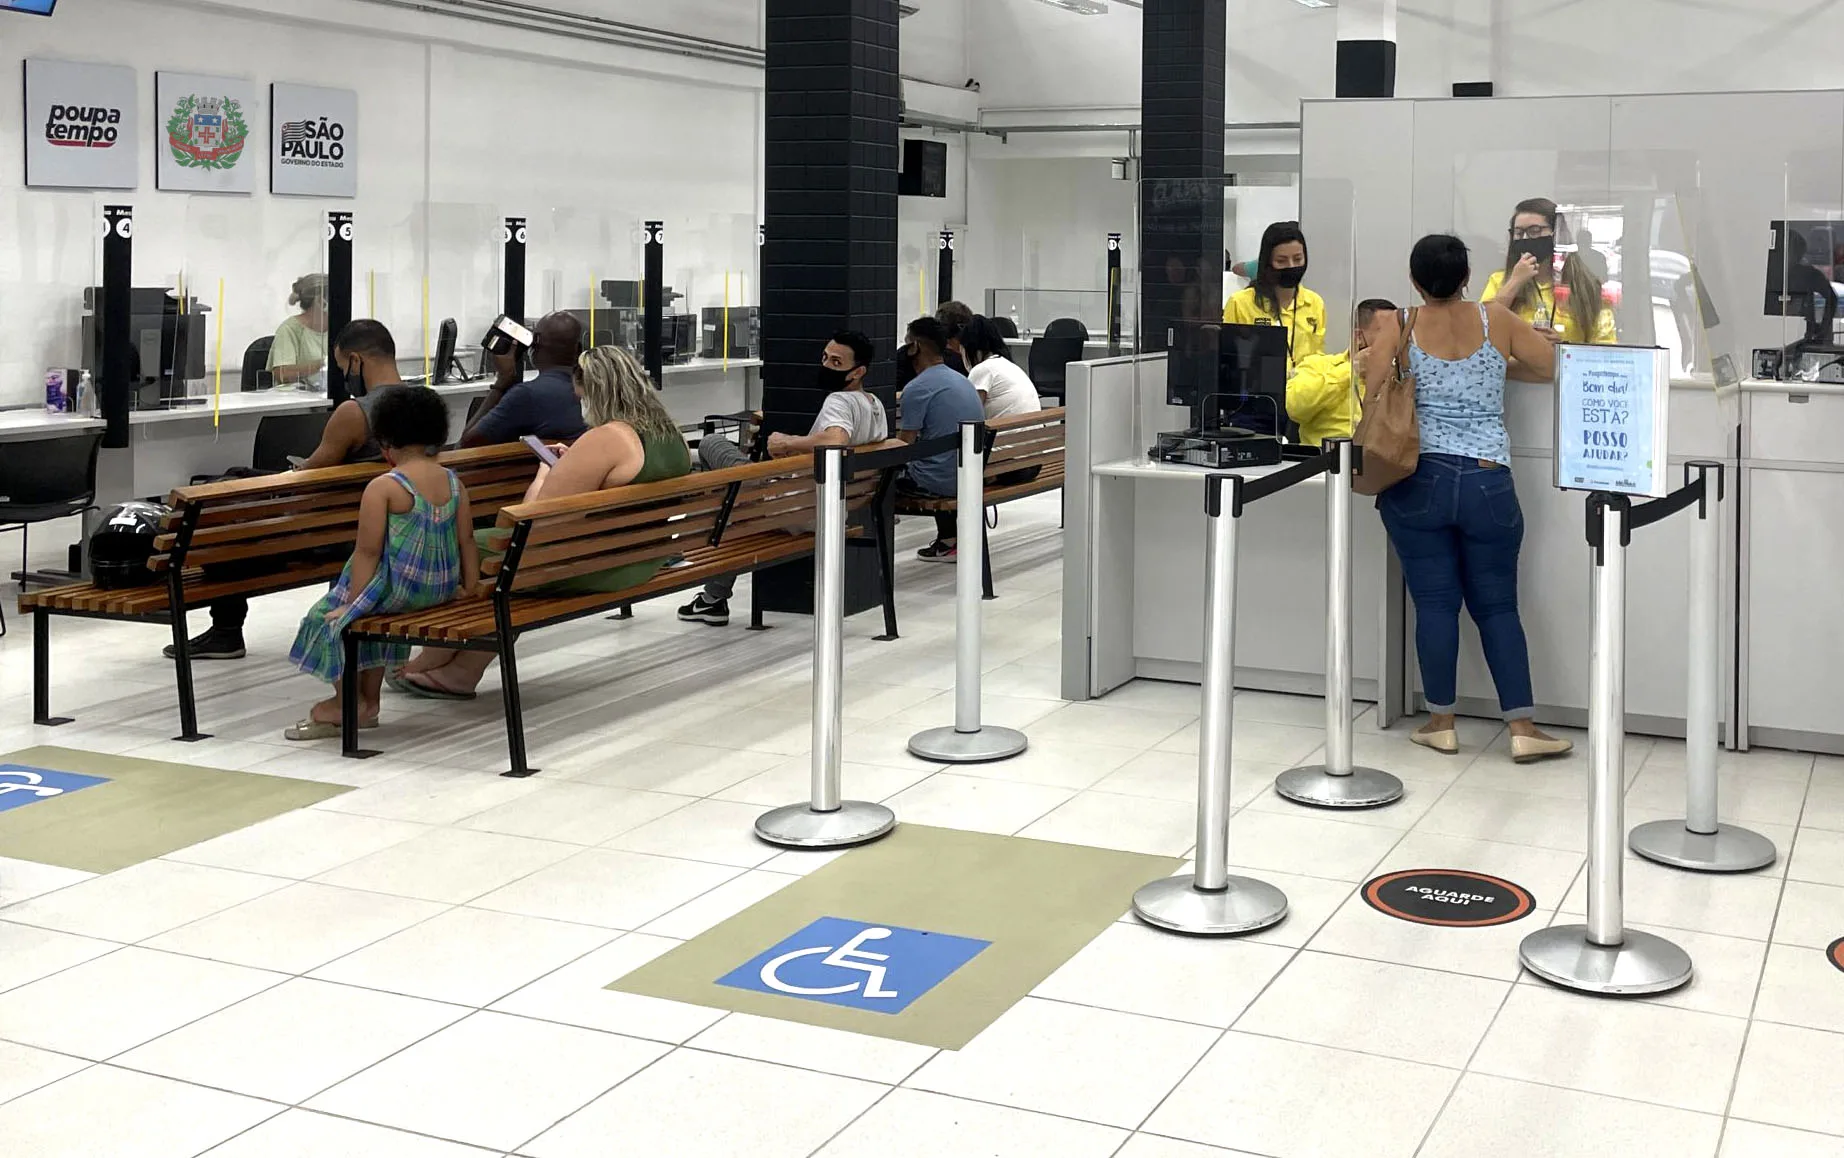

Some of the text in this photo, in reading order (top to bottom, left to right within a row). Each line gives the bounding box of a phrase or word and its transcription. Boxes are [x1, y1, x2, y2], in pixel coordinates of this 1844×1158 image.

[48, 105, 121, 126] poupa
[45, 123, 118, 147] tempo
[304, 116, 344, 141] SÃO
[281, 140, 344, 160] PAULO
[281, 158, 310, 166] GOVERNO
[1582, 380, 1605, 393] Bom
[1582, 398, 1606, 408] COMO
[1583, 429, 1628, 448] POSSO
[1582, 448, 1629, 461] AJUDAR?
[1405, 886, 1495, 903] AGUARDE
[1421, 894, 1470, 906] AQUI
